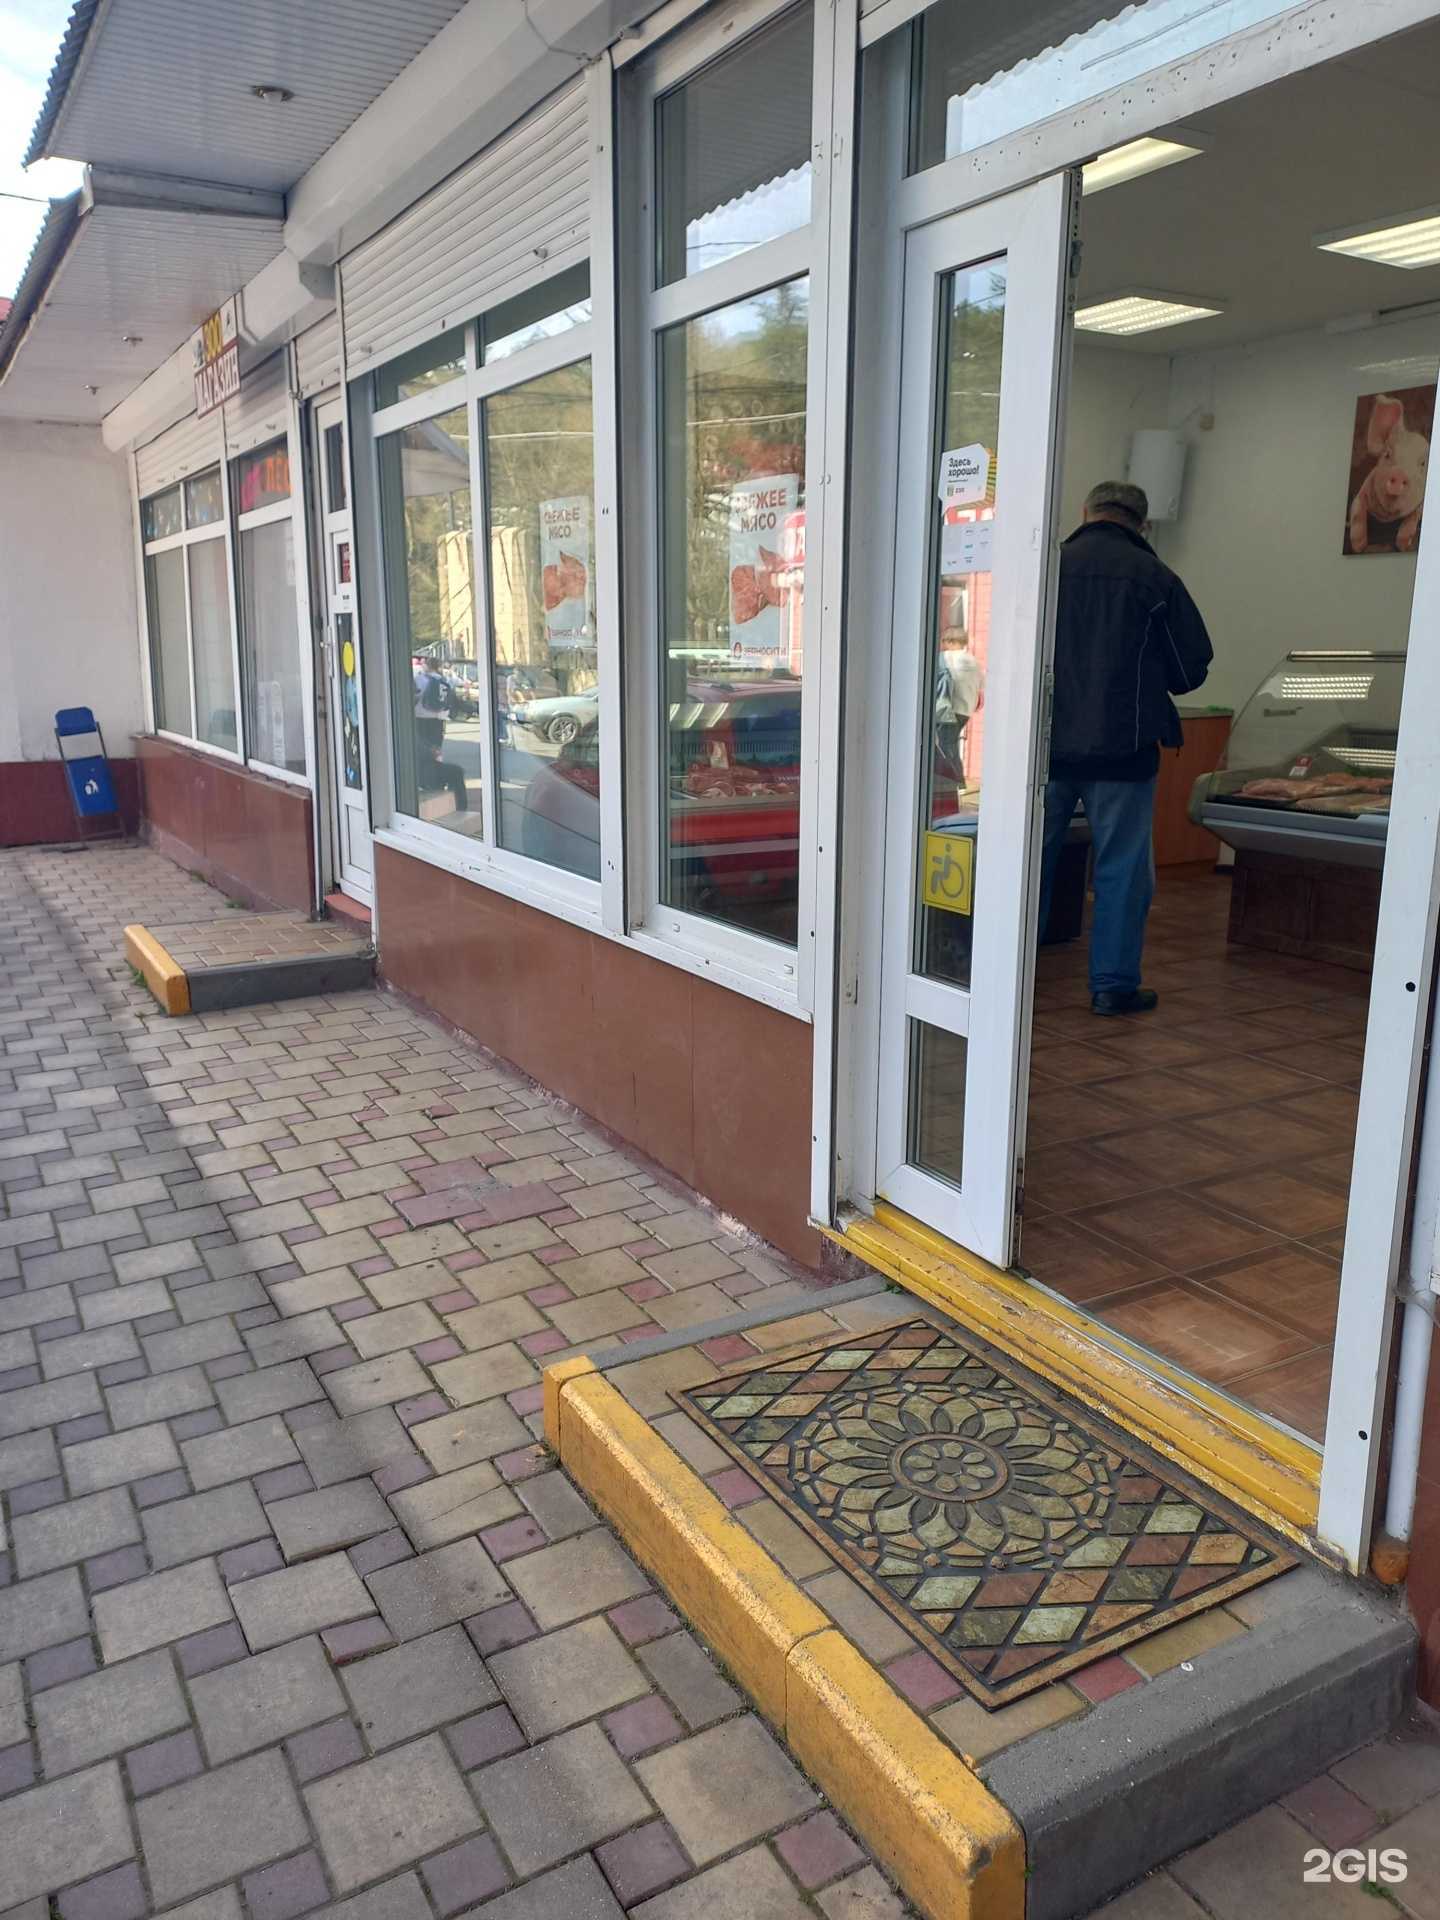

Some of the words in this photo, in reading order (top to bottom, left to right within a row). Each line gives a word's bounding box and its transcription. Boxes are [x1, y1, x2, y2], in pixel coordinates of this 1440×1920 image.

[202, 309, 223, 362] ЗОО
[195, 345, 240, 415] МАГАЗИН
[948, 457, 971, 468] Здесь
[948, 464, 980, 478] хорошо!
[741, 512, 777, 533] МЯСО
